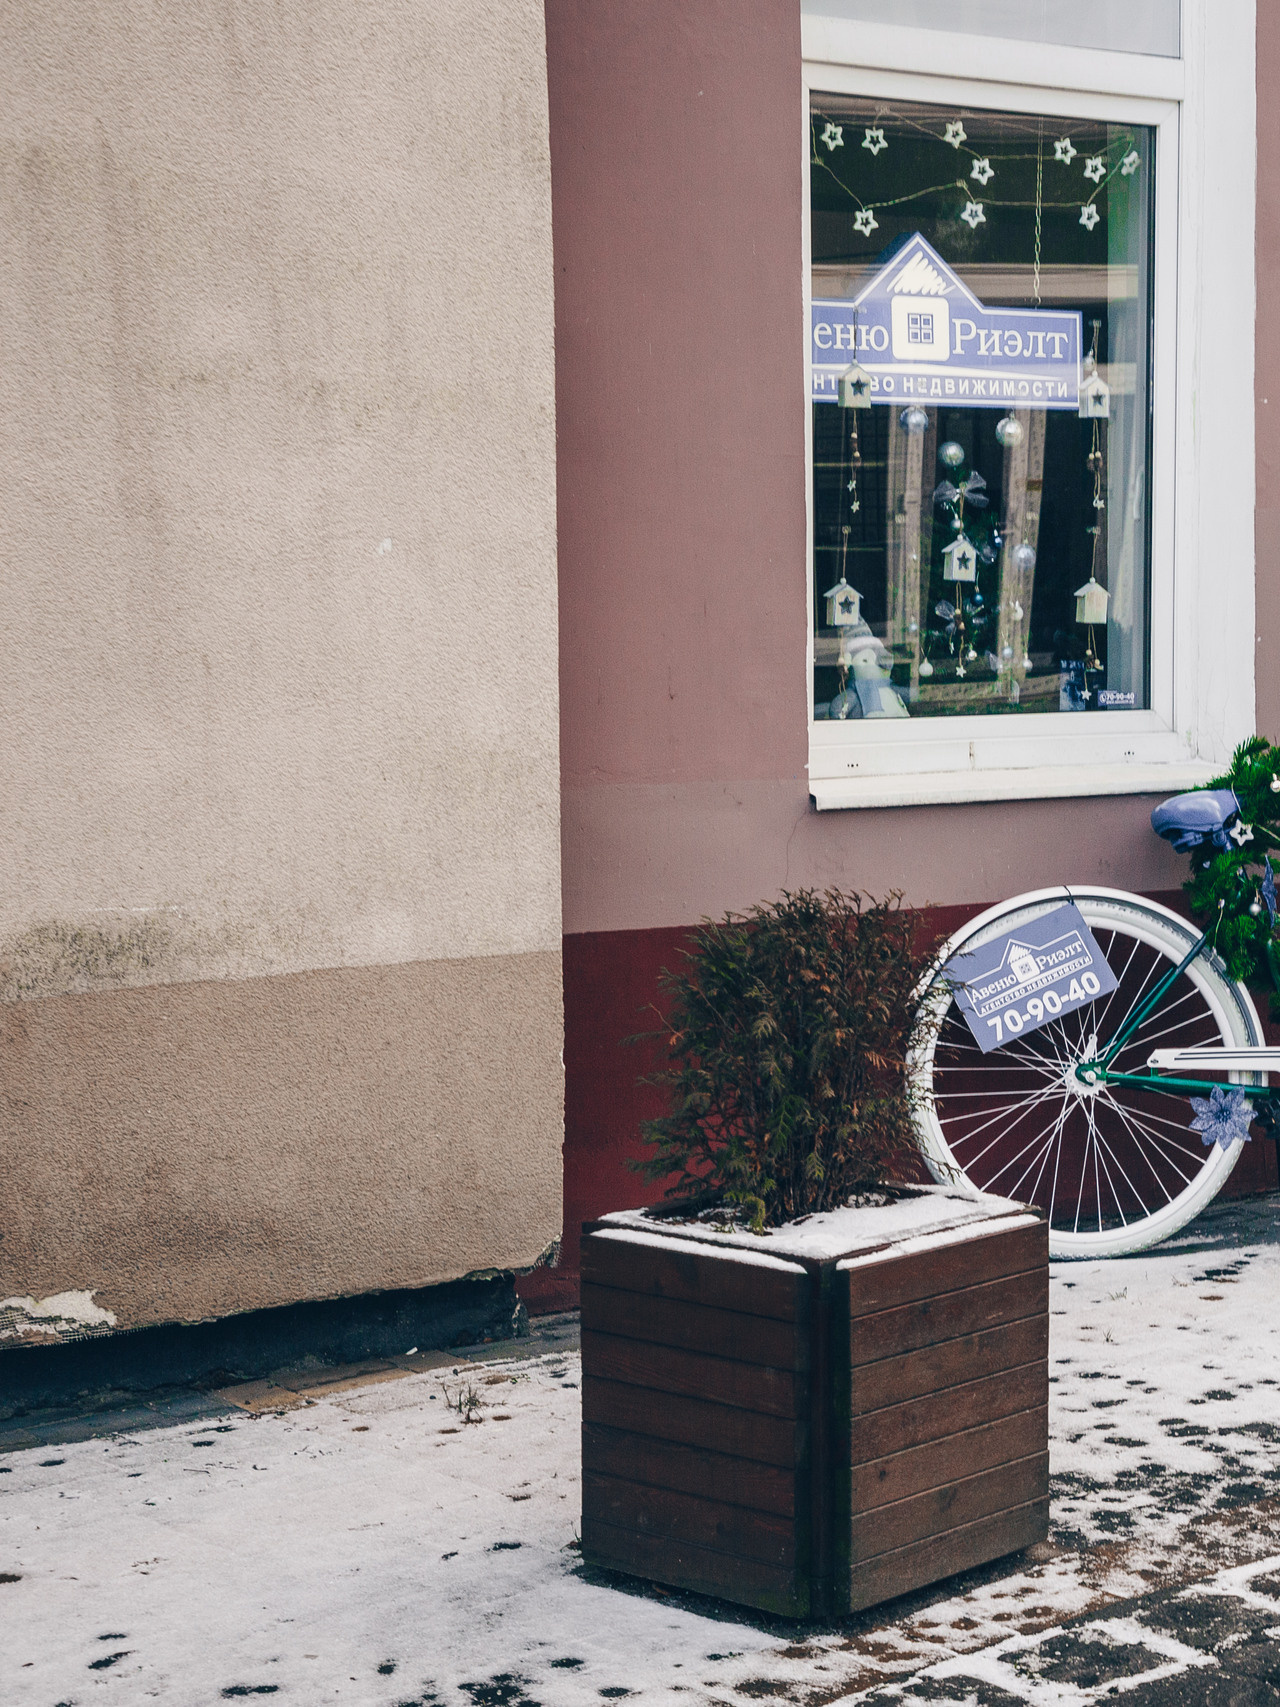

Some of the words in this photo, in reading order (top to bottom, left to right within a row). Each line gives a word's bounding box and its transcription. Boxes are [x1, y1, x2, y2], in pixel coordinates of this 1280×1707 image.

[952, 318, 1068, 359] Риэлт
[813, 373, 895, 392] НТВО
[903, 376, 1068, 398] НЕДВИЖИМОСТИ
[971, 974, 1017, 1003] Авеню
[1035, 940, 1083, 971] Риэлт
[980, 987, 1025, 1015] АГЕНТСТВО
[1026, 957, 1091, 991] НЕДВИЖИМОСТИ
[987, 971, 1101, 1042] 70-90-40
